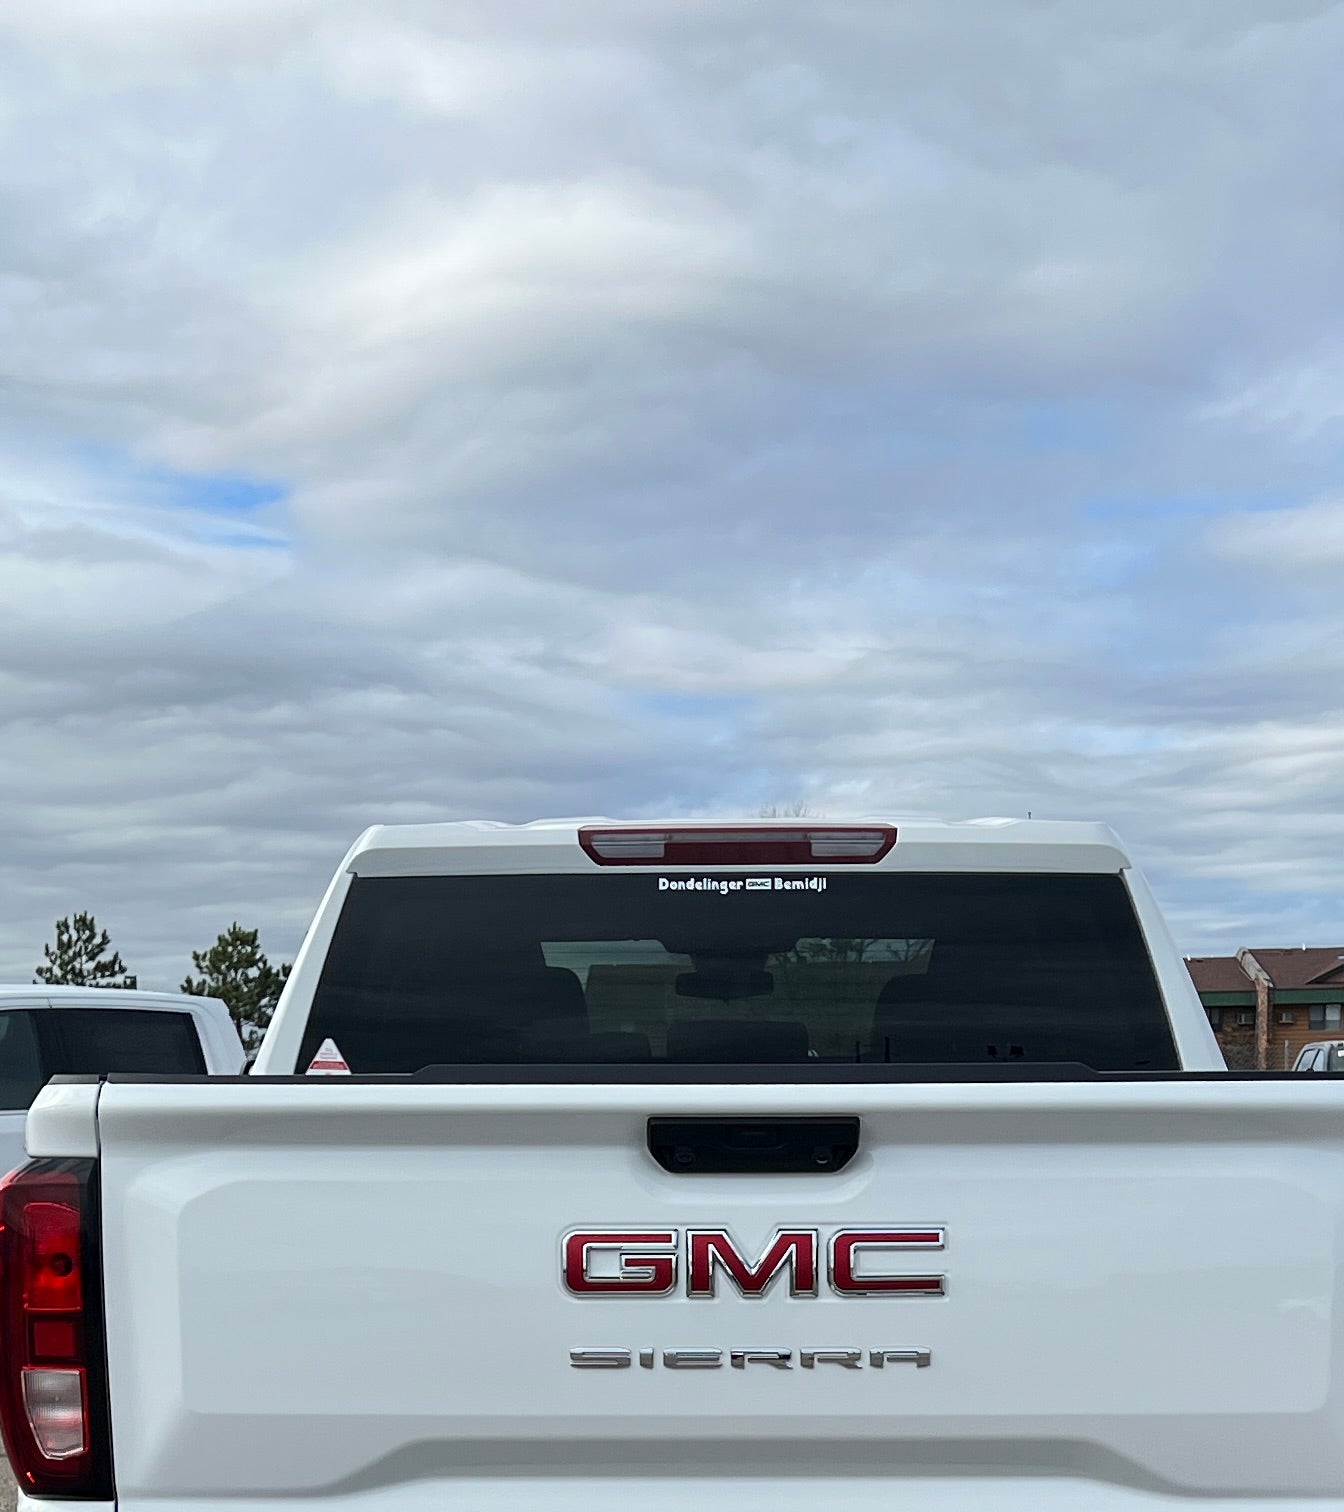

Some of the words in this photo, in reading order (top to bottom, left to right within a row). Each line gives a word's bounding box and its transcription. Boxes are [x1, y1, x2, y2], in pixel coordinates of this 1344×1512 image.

[658, 877, 744, 895] Dondelinger
[774, 877, 827, 892] Bemidji
[562, 1228, 946, 1300] GMC
[569, 1346, 932, 1369] SIERRA
